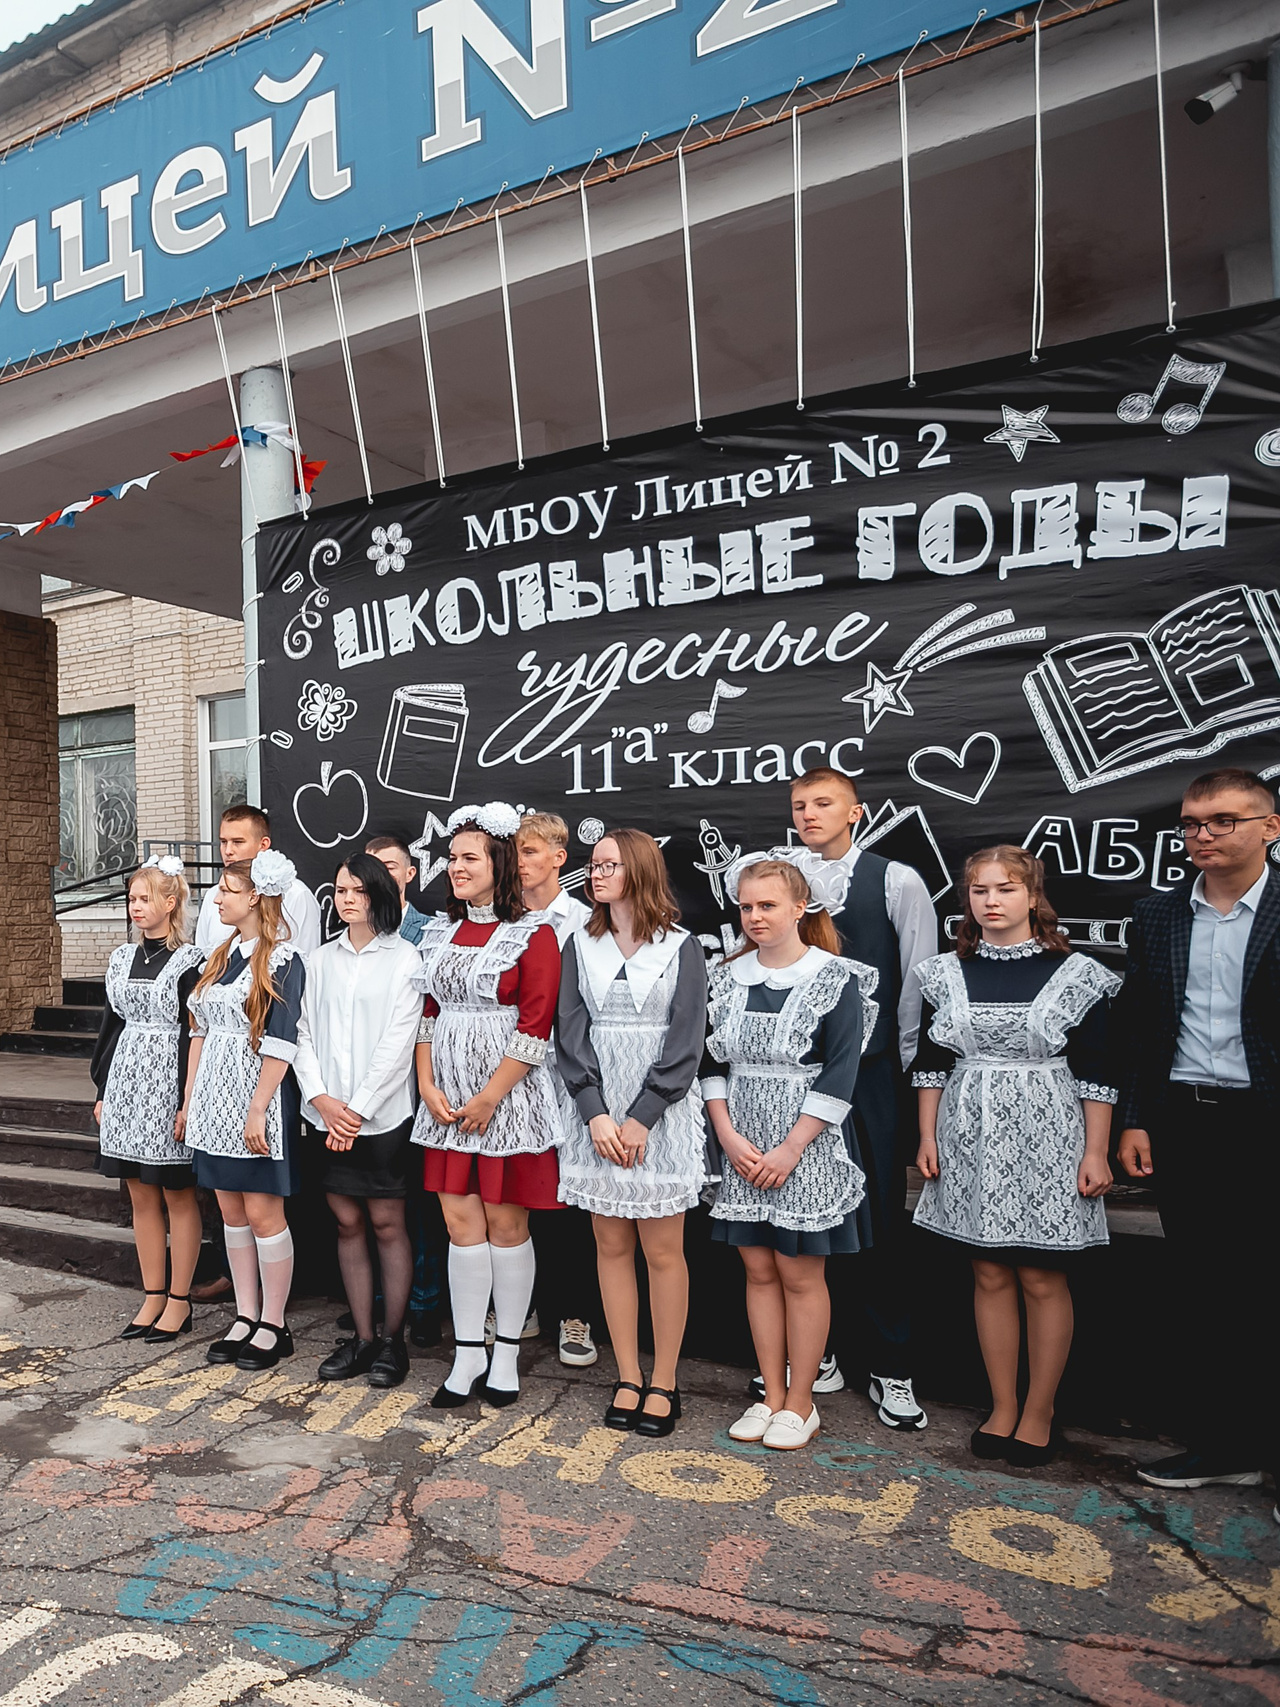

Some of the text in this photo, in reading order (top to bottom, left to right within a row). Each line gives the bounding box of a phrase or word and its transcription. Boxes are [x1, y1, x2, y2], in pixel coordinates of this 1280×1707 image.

[463, 486, 618, 552] МБОУ
[632, 455, 813, 522] Лицей
[918, 424, 951, 468] 2
[333, 474, 1231, 670] ШКОЛЬНЫЕ ГОДЫ
[477, 611, 888, 768] чудесные
[668, 736, 865, 789] класс
